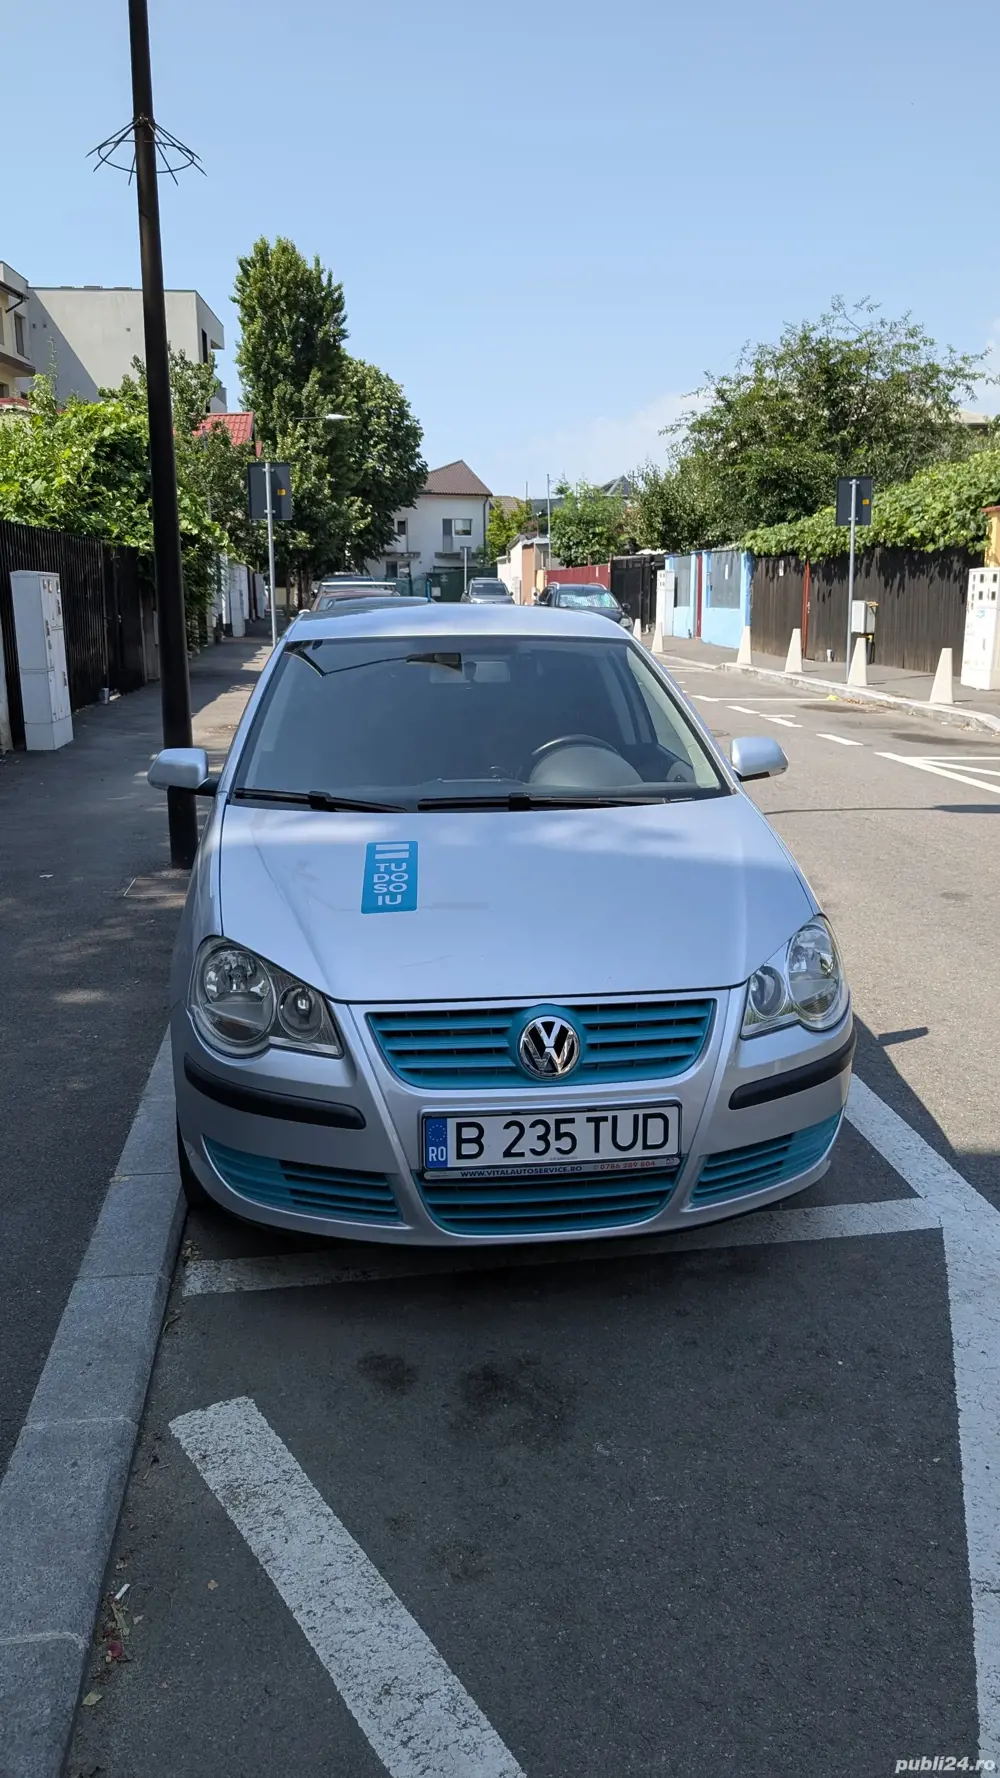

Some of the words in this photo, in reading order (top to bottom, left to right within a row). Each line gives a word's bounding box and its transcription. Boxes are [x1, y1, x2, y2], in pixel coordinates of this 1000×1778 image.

[375, 862, 407, 872] TU
[373, 872, 409, 883] DO
[373, 882, 407, 894] SO
[377, 894, 402, 906] IU
[519, 1015, 580, 1079] VW
[455, 1121, 485, 1160] B
[502, 1117, 578, 1158] 235
[586, 1112, 669, 1154] TUD
[428, 1146, 447, 1162] RO
[460, 1165, 583, 1178] WWW.VITALAUTOSERVICE.RO
